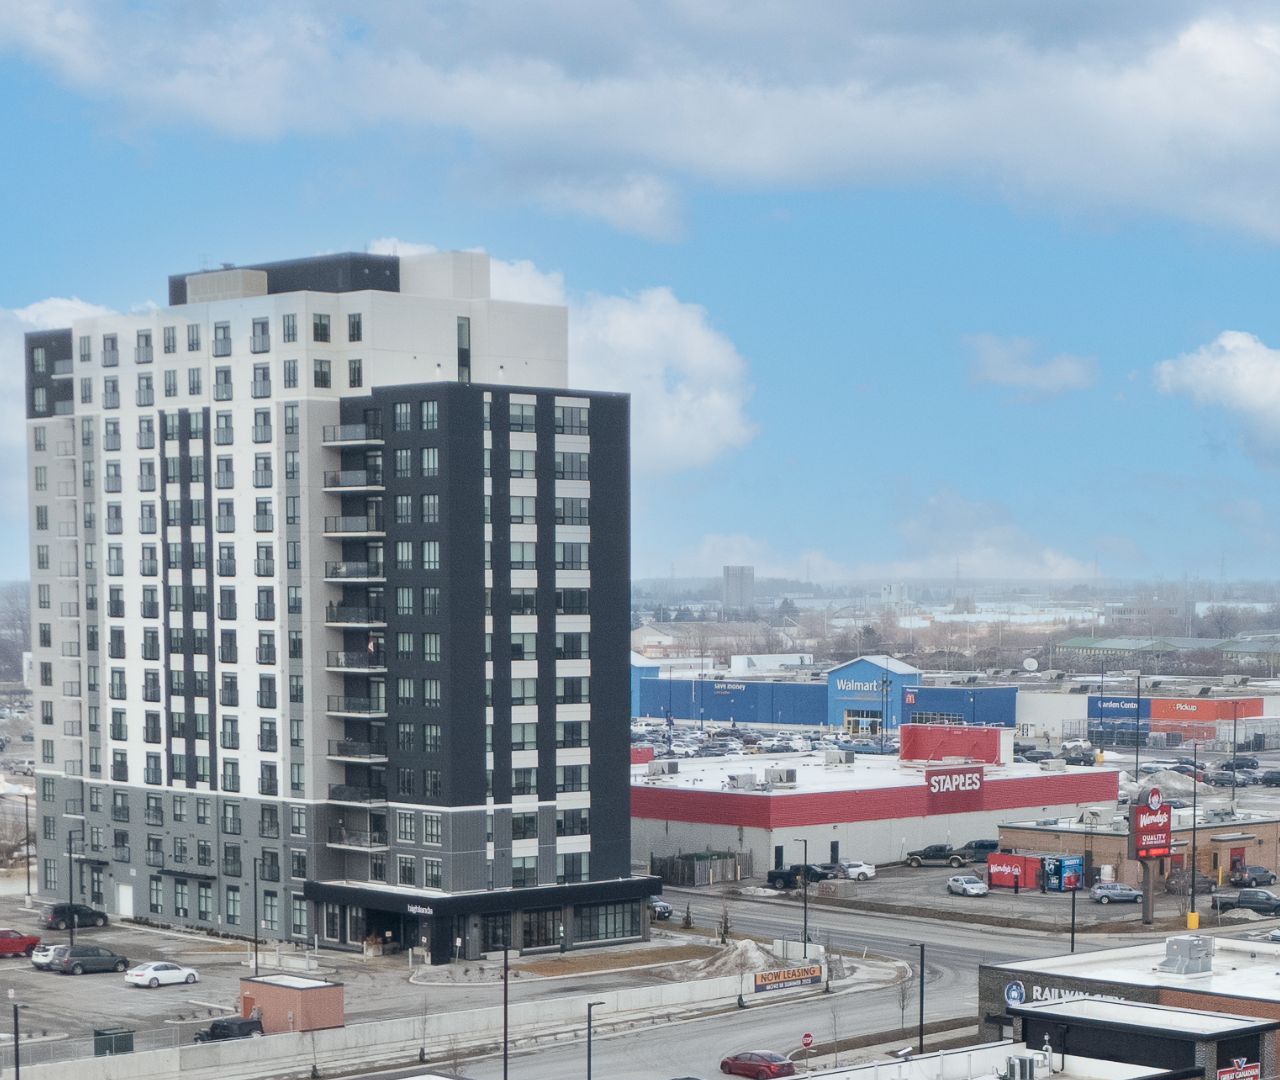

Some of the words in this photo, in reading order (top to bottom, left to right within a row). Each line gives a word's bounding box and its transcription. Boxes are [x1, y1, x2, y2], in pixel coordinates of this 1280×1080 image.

[836, 679, 878, 692] Walmart
[1175, 703, 1198, 712] Pickup
[930, 773, 981, 793] STAPLES
[1140, 810, 1169, 828] Wendy's
[1142, 833, 1167, 842] QUALITY
[407, 903, 434, 915] highlands
